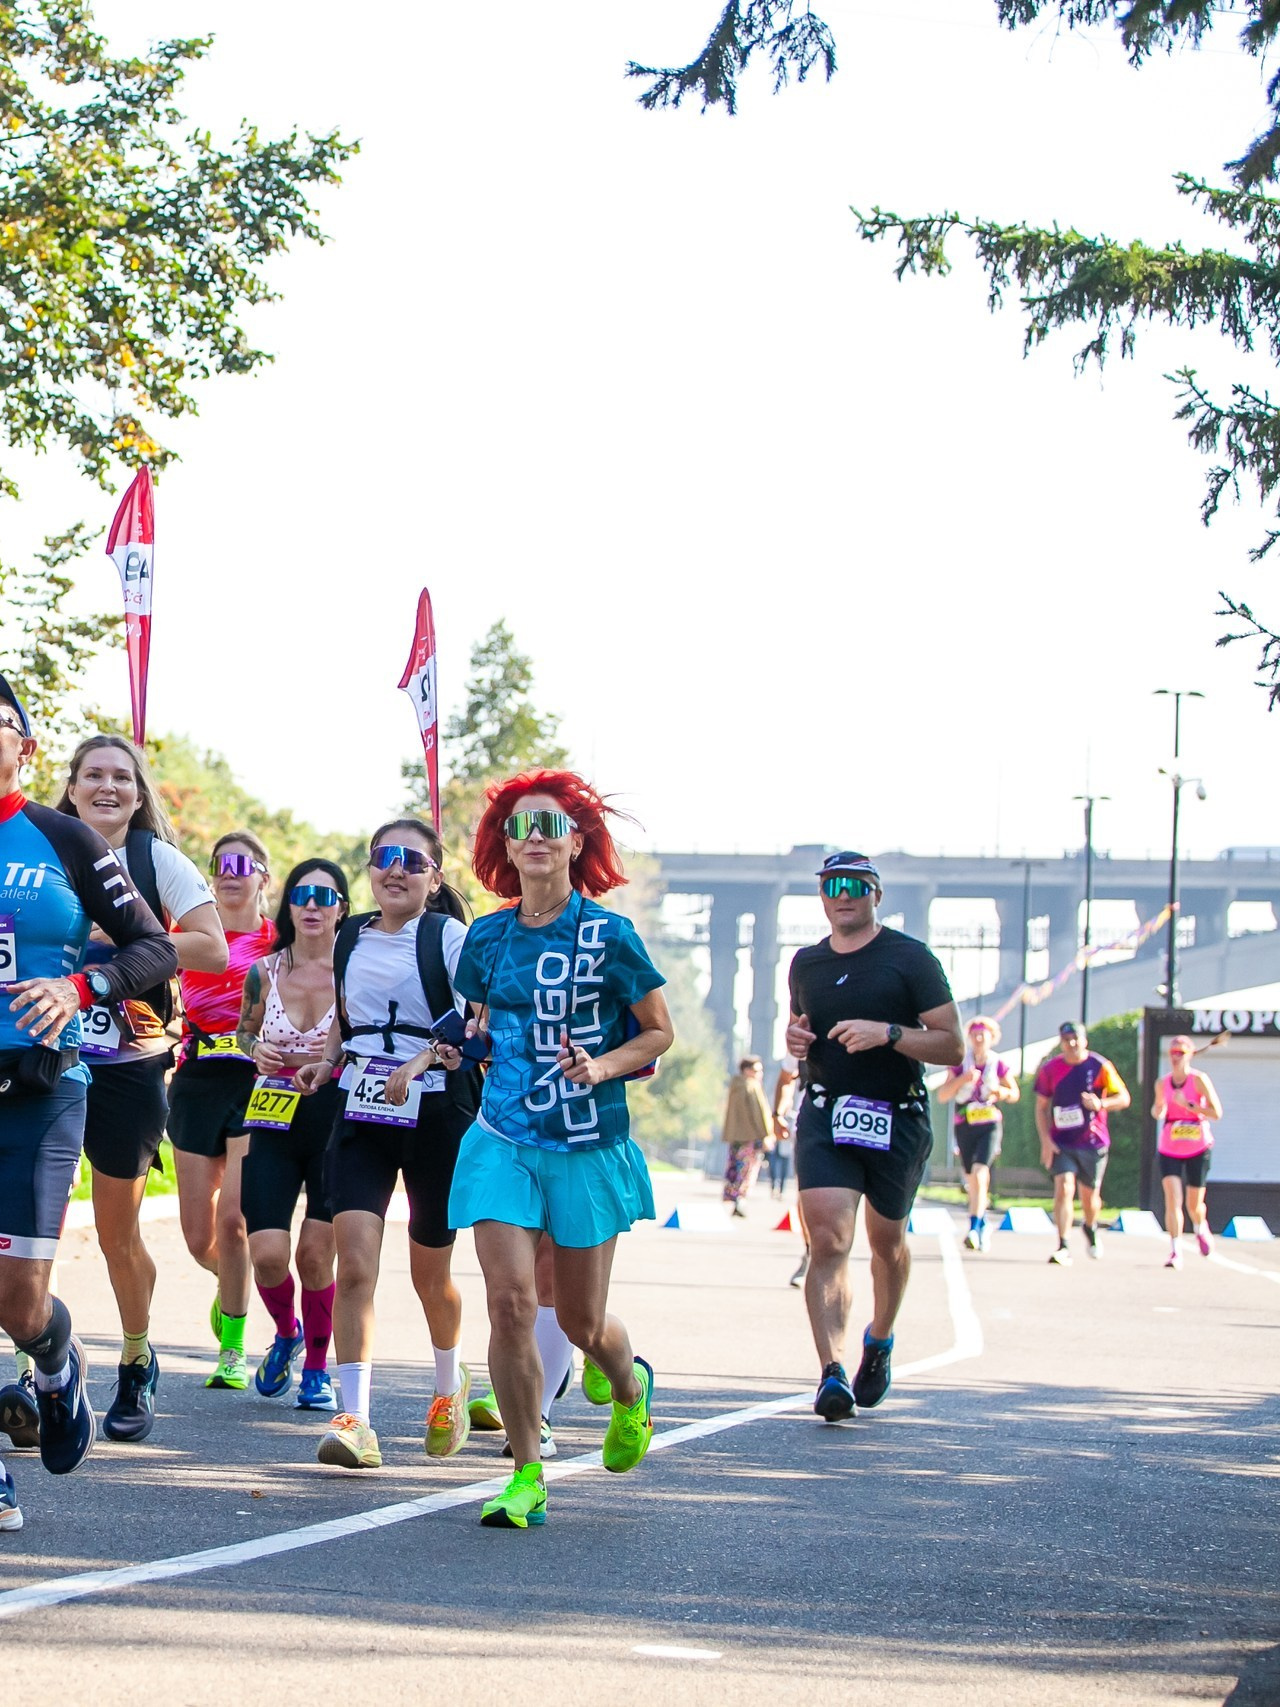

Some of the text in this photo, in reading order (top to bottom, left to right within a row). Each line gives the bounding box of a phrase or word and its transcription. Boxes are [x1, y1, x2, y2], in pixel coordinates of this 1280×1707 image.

[4, 862, 47, 888] Tri
[93, 848, 139, 908] Tri
[0, 887, 39, 901] atleta
[61, 944, 82, 979] Tr
[524, 951, 570, 1112] ONEGO
[1191, 1009, 1280, 1033] МОР
[250, 1091, 295, 1113] 4277
[832, 1111, 888, 1136] 4098
